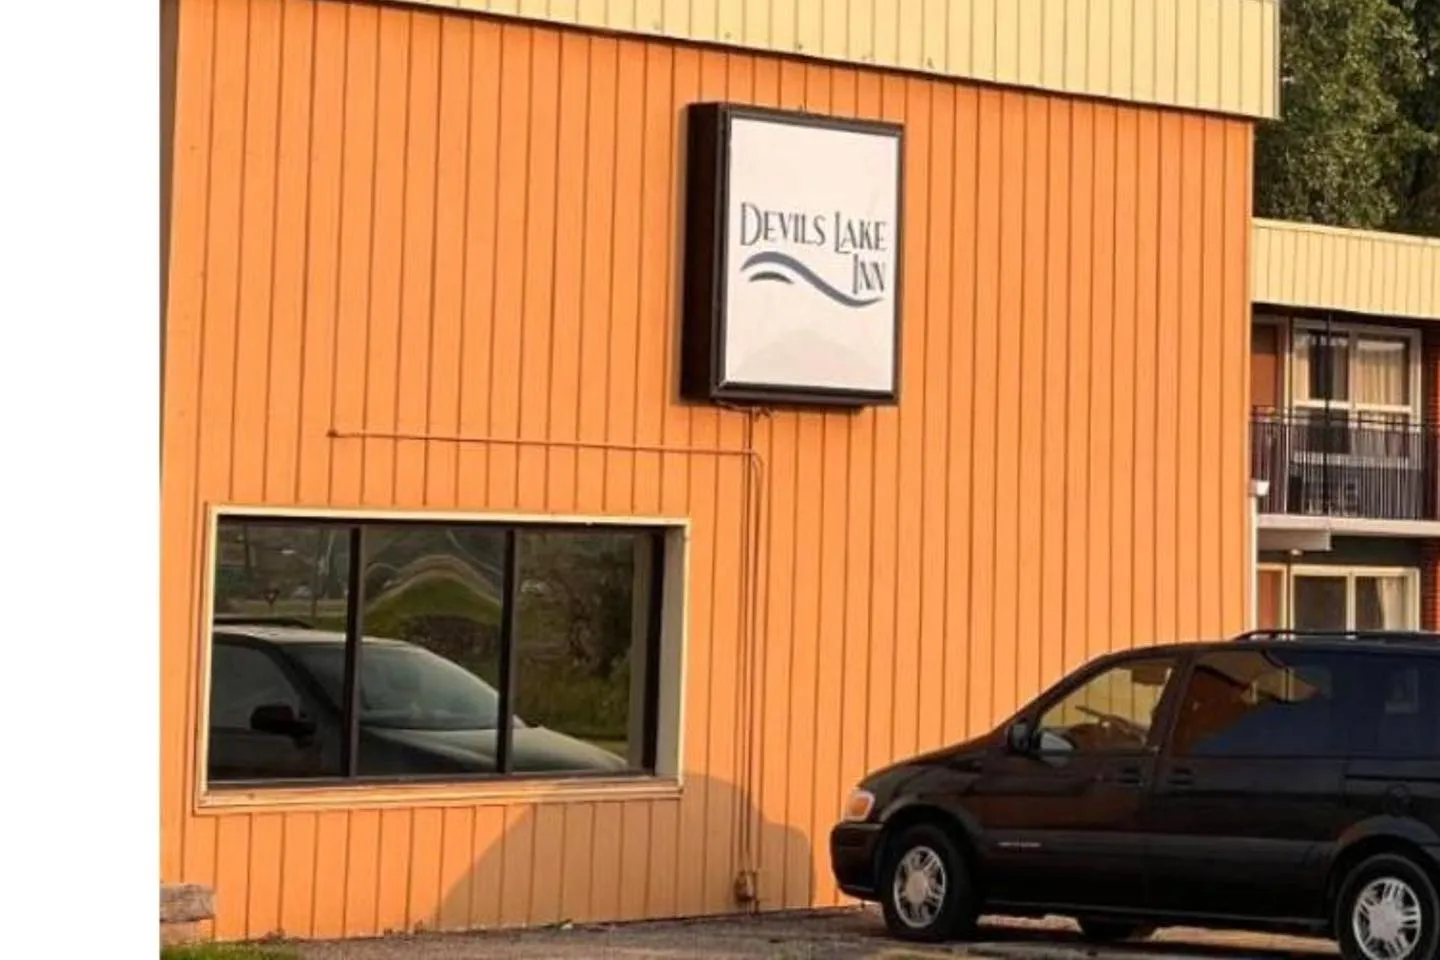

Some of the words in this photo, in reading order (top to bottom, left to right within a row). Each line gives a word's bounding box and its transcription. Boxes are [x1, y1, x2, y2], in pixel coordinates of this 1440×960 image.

[740, 201, 826, 247] DEVILS
[834, 211, 887, 254] LAKE
[852, 255, 885, 295] INN
